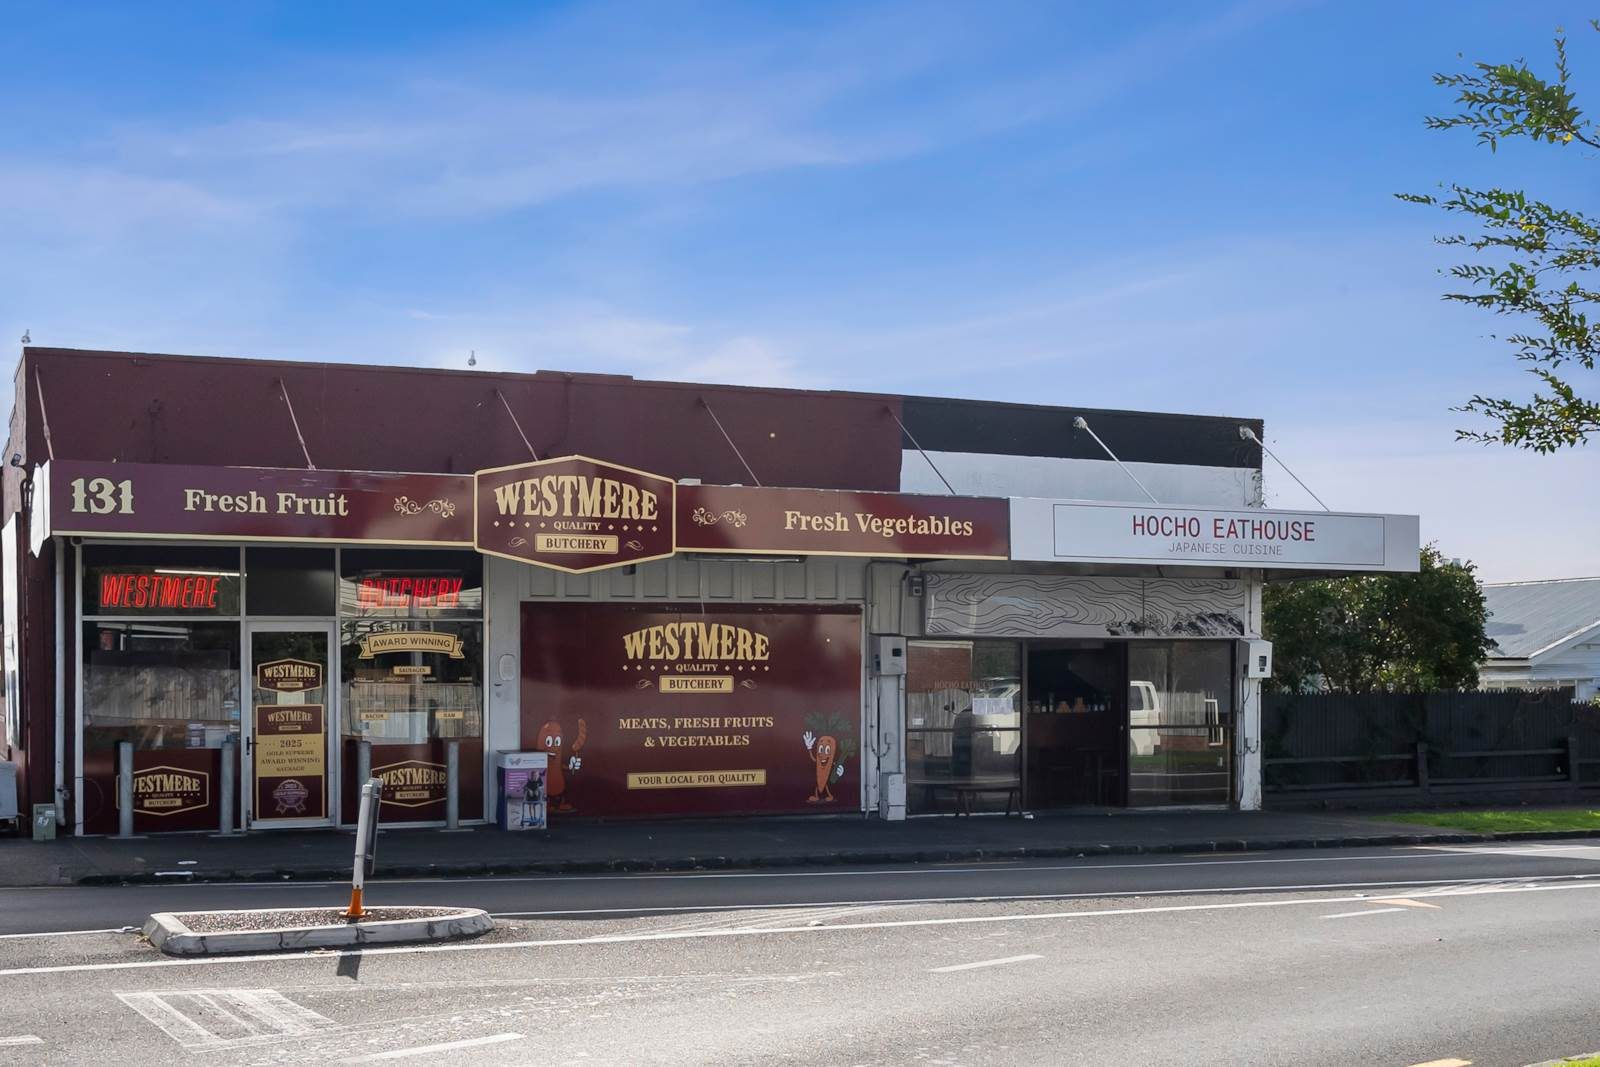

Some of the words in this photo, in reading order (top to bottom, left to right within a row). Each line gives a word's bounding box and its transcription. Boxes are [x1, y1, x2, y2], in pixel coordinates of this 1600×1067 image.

[71, 478, 135, 514] 131
[184, 489, 268, 513] Fresh
[276, 492, 349, 516] Fruit
[493, 475, 658, 520] WESTMERE
[553, 521, 601, 531] QUALITY
[784, 510, 850, 532] Fresh
[855, 513, 973, 537] Vegetables
[1133, 515, 1200, 538] HOCHO
[1213, 518, 1315, 542] EATHOUSE
[546, 538, 608, 550] BUTCHERY
[1168, 543, 1226, 554] JAPANESE
[1233, 544, 1283, 556] CUISINE
[101, 574, 221, 609] WESTMERE
[358, 577, 464, 609] BUTCHERY
[373, 637, 408, 649] AWARD
[410, 637, 451, 649] WINNING
[622, 622, 770, 661] WESTMERE
[264, 664, 317, 678] WESTMERE
[675, 663, 718, 673] QUALITY
[669, 679, 725, 689] BUTCHERY
[267, 710, 313, 722] WESTMERE
[618, 718, 671, 731] MEATS,
[674, 717, 721, 729] FRESH
[724, 716, 774, 728] FRUITS
[280, 740, 303, 748] 2025
[644, 736, 655, 747] &
[659, 735, 750, 747] VEGETABLES
[638, 776, 662, 785] YOUR
[665, 775, 694, 784] LOCAL
[697, 774, 716, 783] FOR
[718, 773, 757, 783] QUALITY
